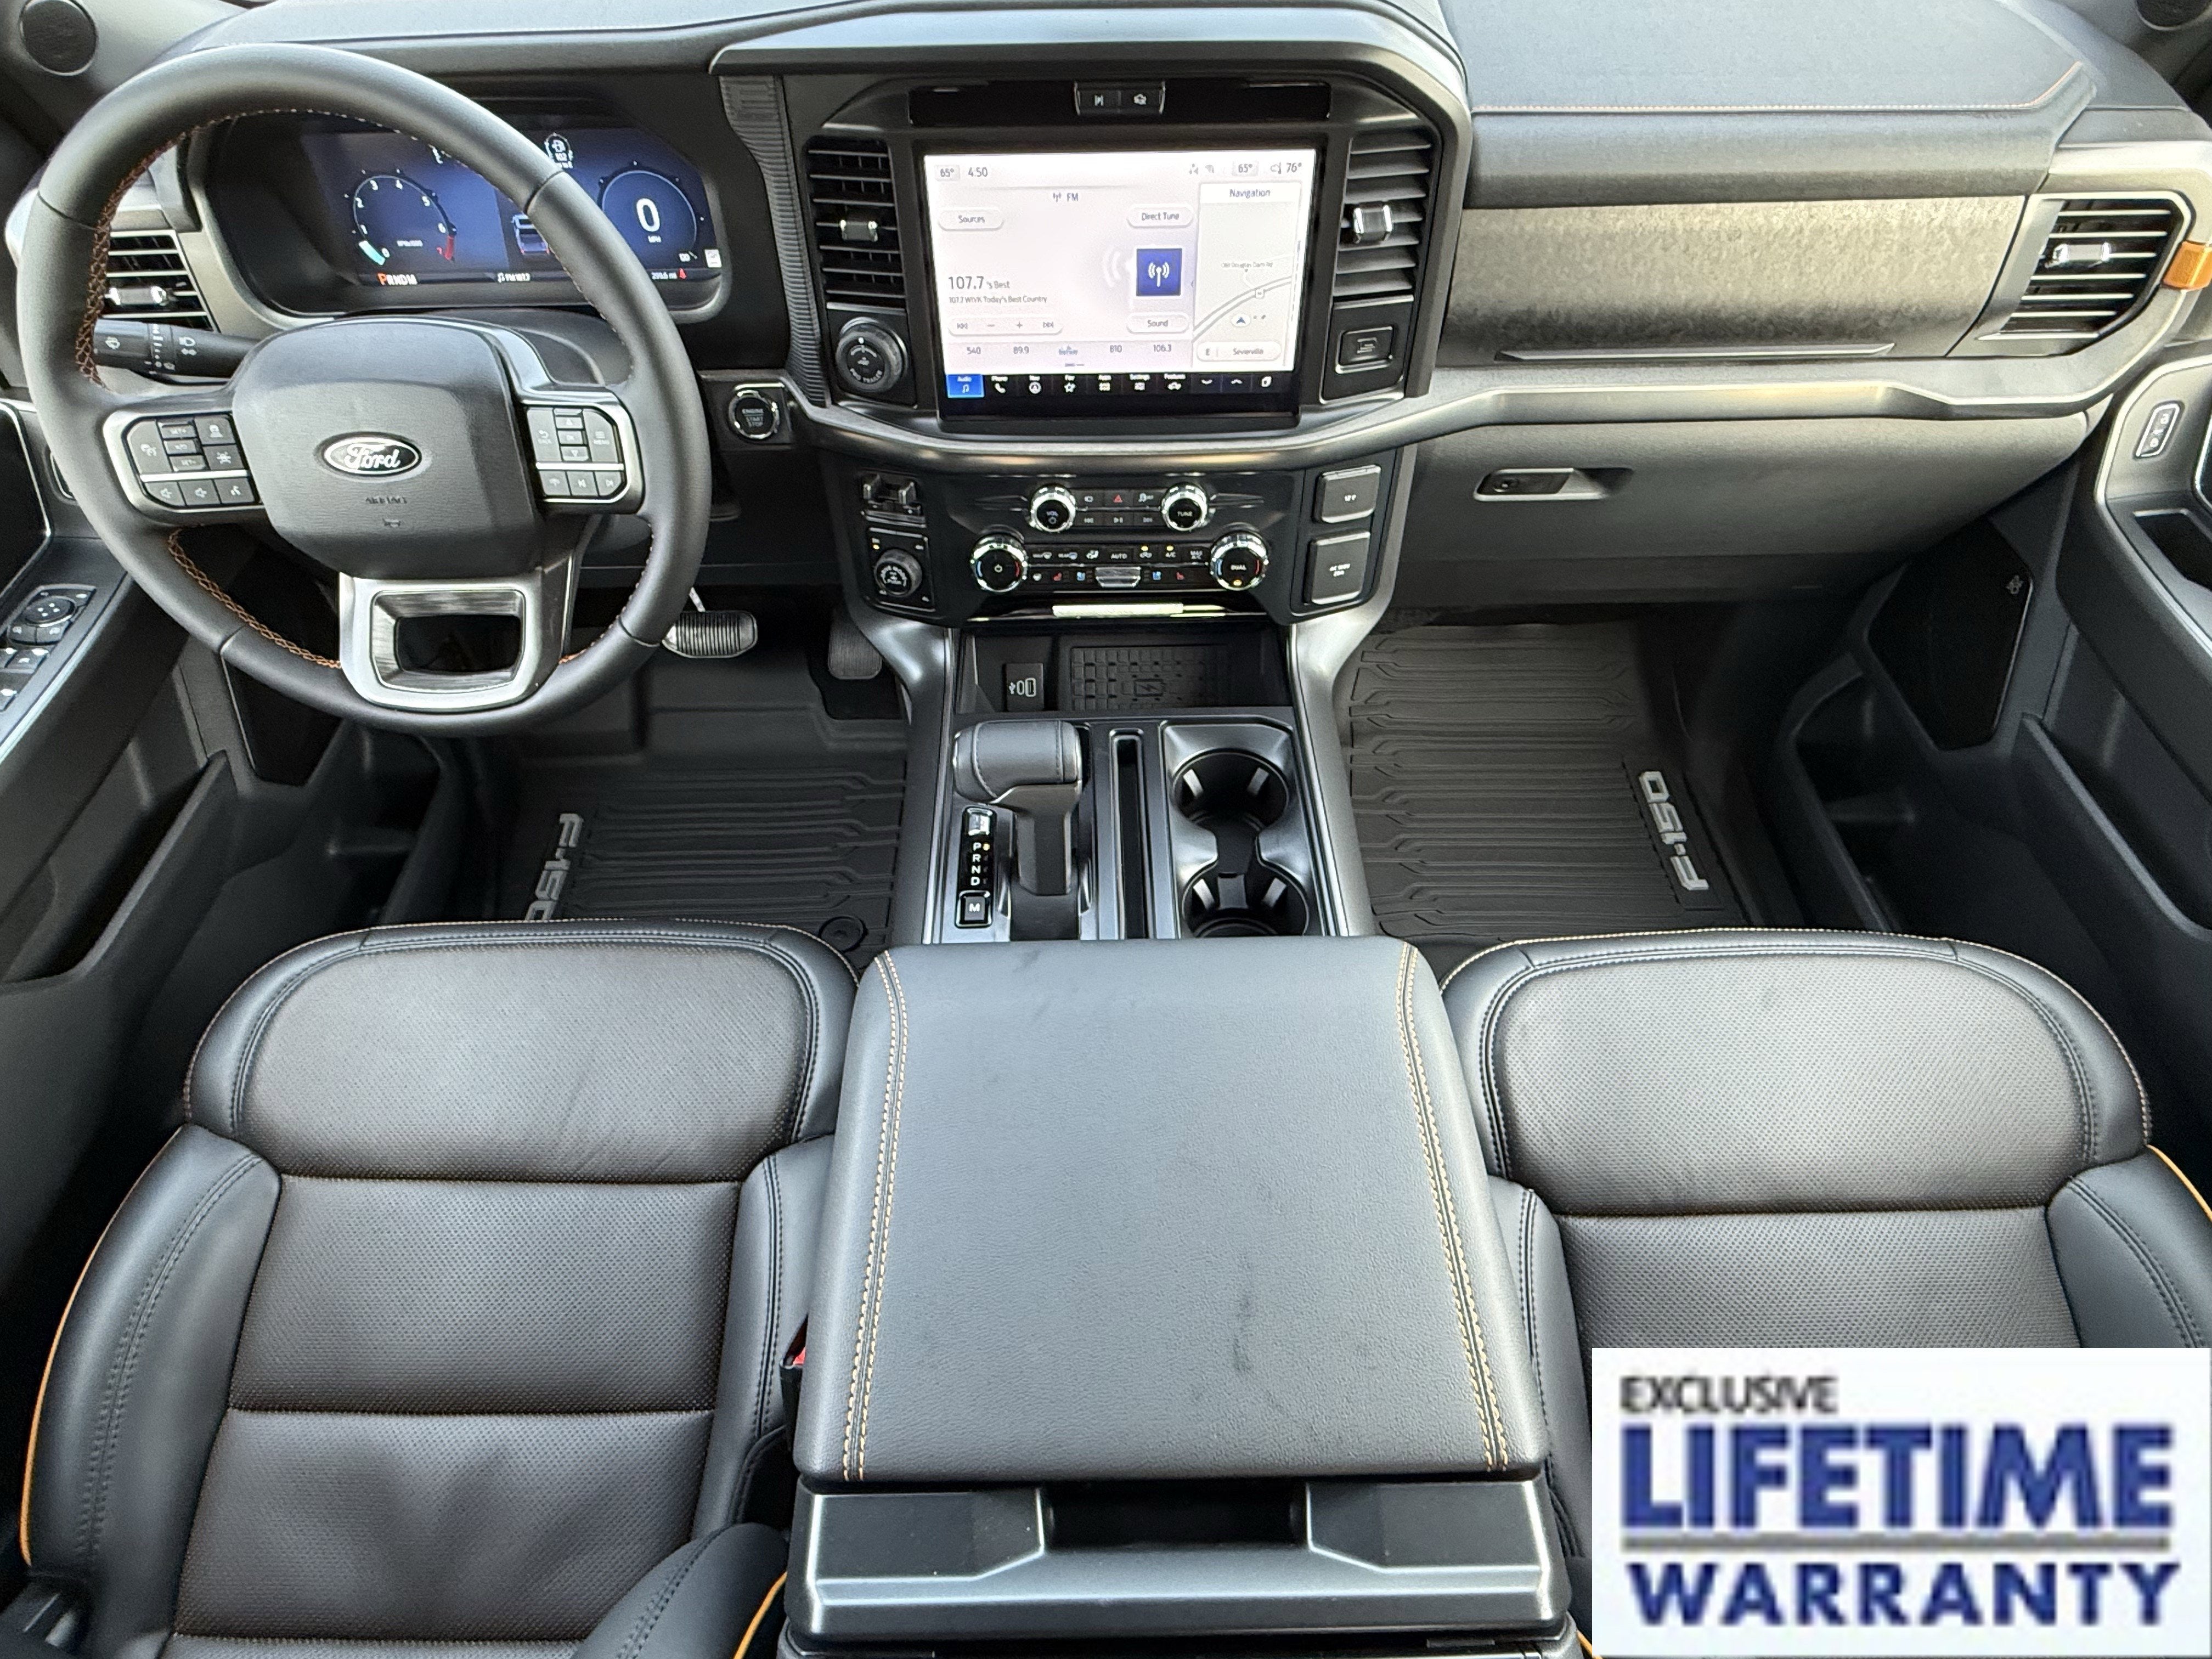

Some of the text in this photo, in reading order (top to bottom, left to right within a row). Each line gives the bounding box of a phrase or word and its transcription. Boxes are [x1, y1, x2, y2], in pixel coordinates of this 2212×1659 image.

[1066, 193, 1079, 202] FM
[1229, 189, 1271, 199] Navigation
[636, 198, 661, 232] 0
[958, 215, 985, 223] Sources
[1141, 212, 1179, 221] Direct Tune
[948, 275, 984, 290] 107.7
[994, 280, 1011, 289] Best
[1147, 319, 1169, 328] Sound
[344, 443, 401, 469] Ford
[1638, 770, 1709, 891] F-150
[973, 842, 982, 851] P
[972, 854, 981, 862] R
[971, 865, 981, 874] N
[970, 877, 980, 885] D
[969, 903, 981, 912] M
